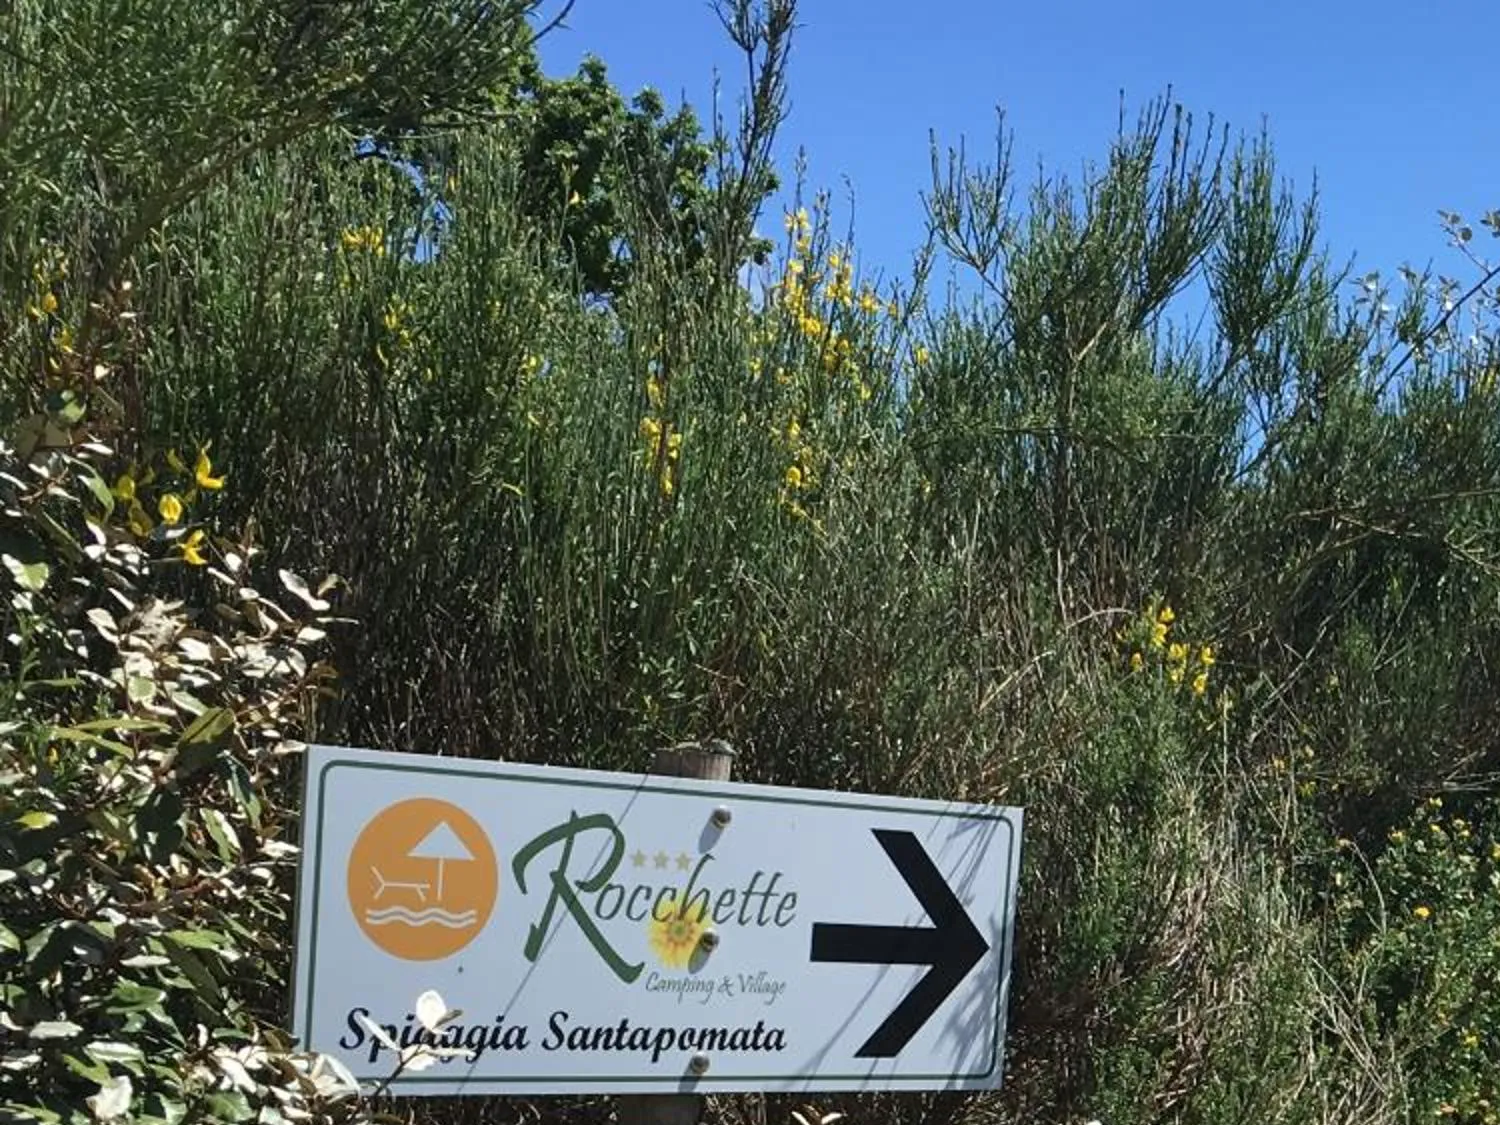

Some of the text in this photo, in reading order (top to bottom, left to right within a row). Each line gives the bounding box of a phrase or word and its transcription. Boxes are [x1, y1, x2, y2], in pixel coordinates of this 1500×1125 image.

[512, 810, 797, 983] Rocchette
[645, 971, 787, 1005] Camping & Village
[541, 1011, 787, 1063] Santapomata
